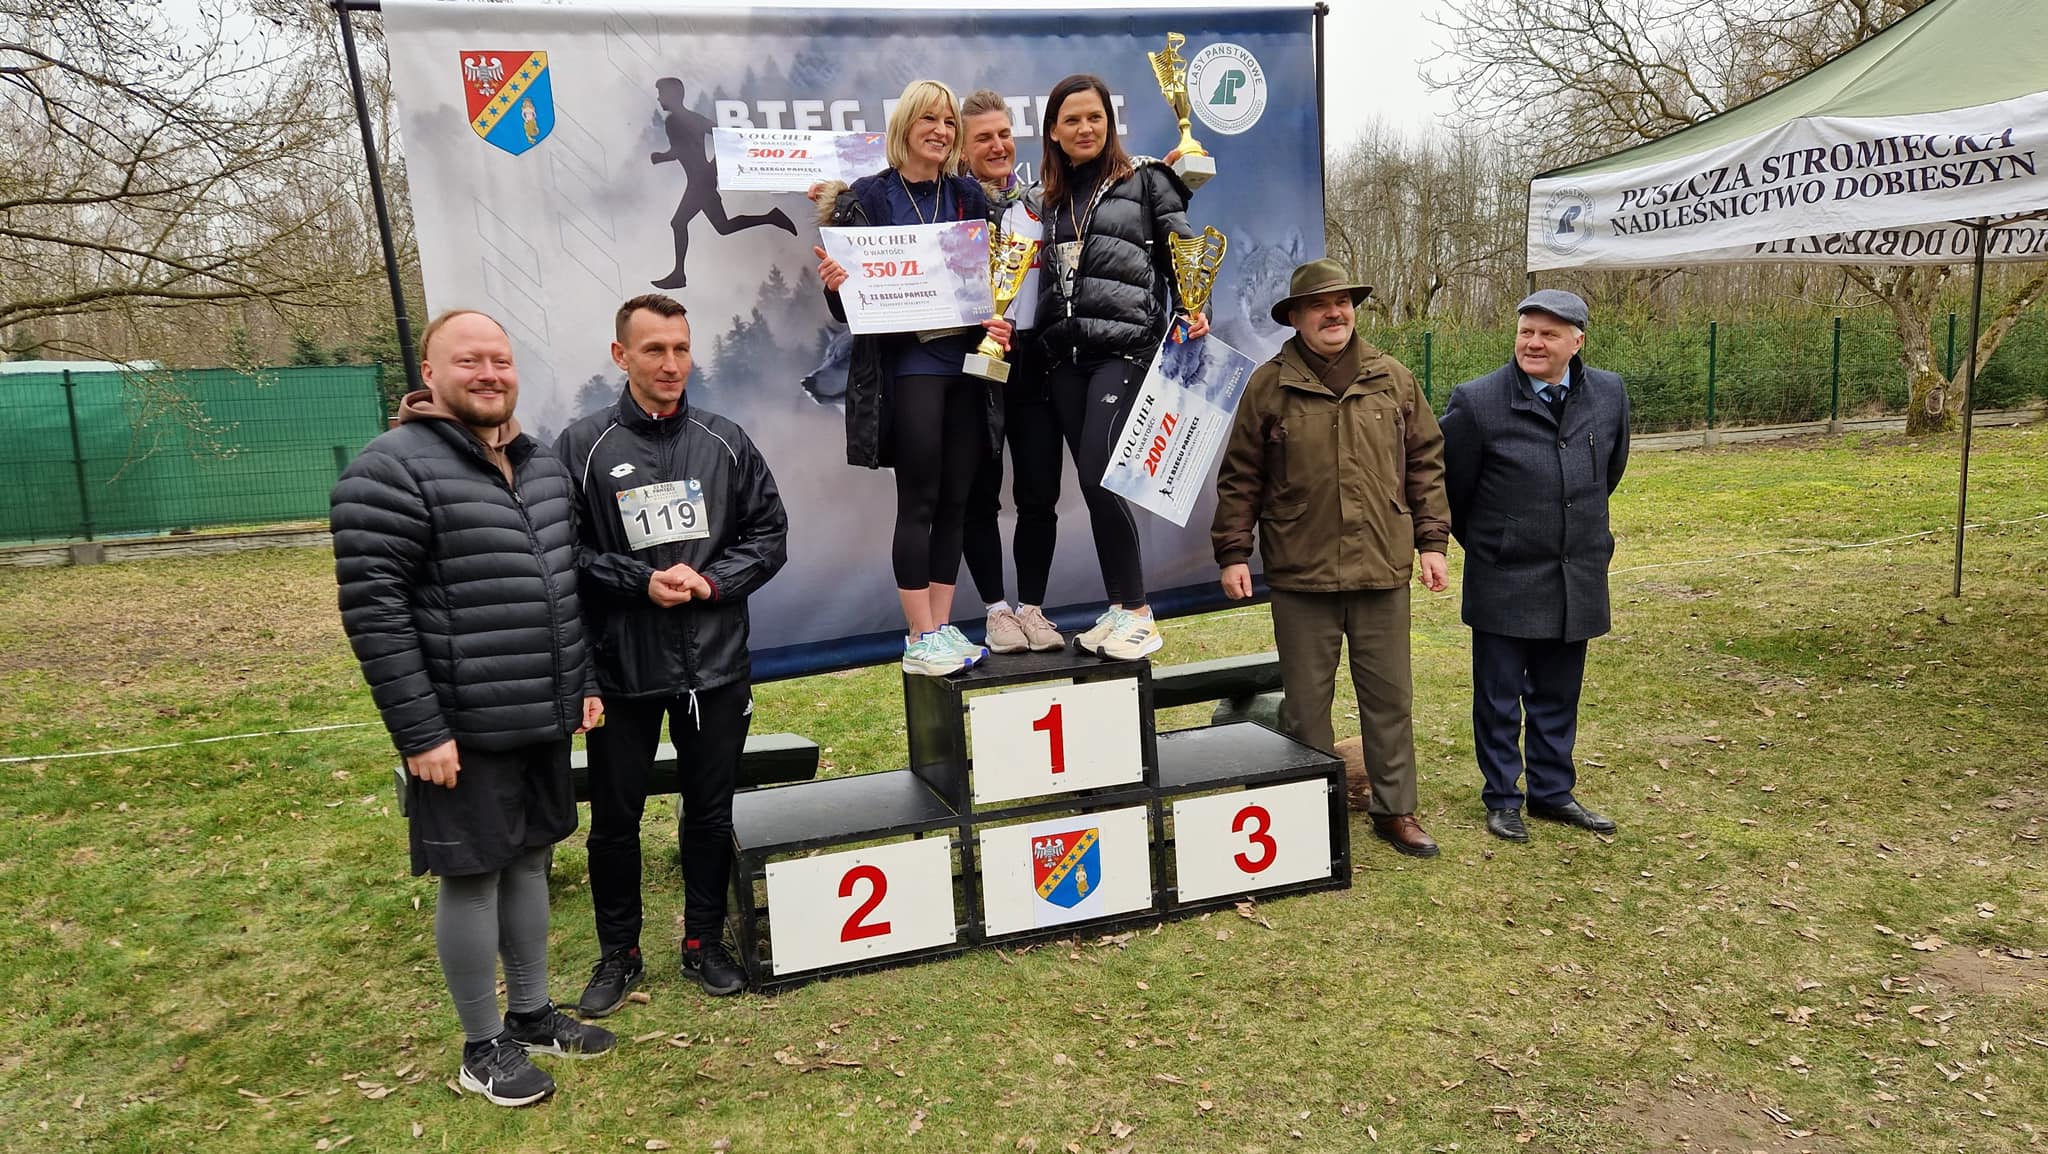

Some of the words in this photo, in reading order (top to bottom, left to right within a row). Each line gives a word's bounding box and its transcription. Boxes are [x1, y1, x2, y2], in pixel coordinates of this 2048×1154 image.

[1190, 56, 1206, 86] LASY
[738, 132, 812, 142] VOUCHER
[747, 148, 785, 159] 500
[1610, 179, 1826, 238] NADLEŚNICTWO
[1833, 150, 2040, 201] DOBIESZYN
[1616, 163, 1754, 212] PUSZCZA
[846, 234, 918, 246] VOUCHER
[861, 262, 897, 279] 350
[900, 260, 924, 276] ZŁ
[879, 292, 904, 301] BIEGU
[905, 290, 937, 299] PAMIĘCI
[1117, 394, 1156, 468] VOUCHER
[1143, 435, 1167, 478] 200
[1159, 411, 1181, 437] ZŁ
[1166, 474, 1175, 485] II
[1172, 450, 1185, 477] BIEGU
[1182, 416, 1200, 451] PAMIĘCI
[635, 502, 697, 536] 119
[1033, 704, 1065, 774] 1
[1231, 805, 1277, 874] 3
[837, 865, 892, 942] 2
